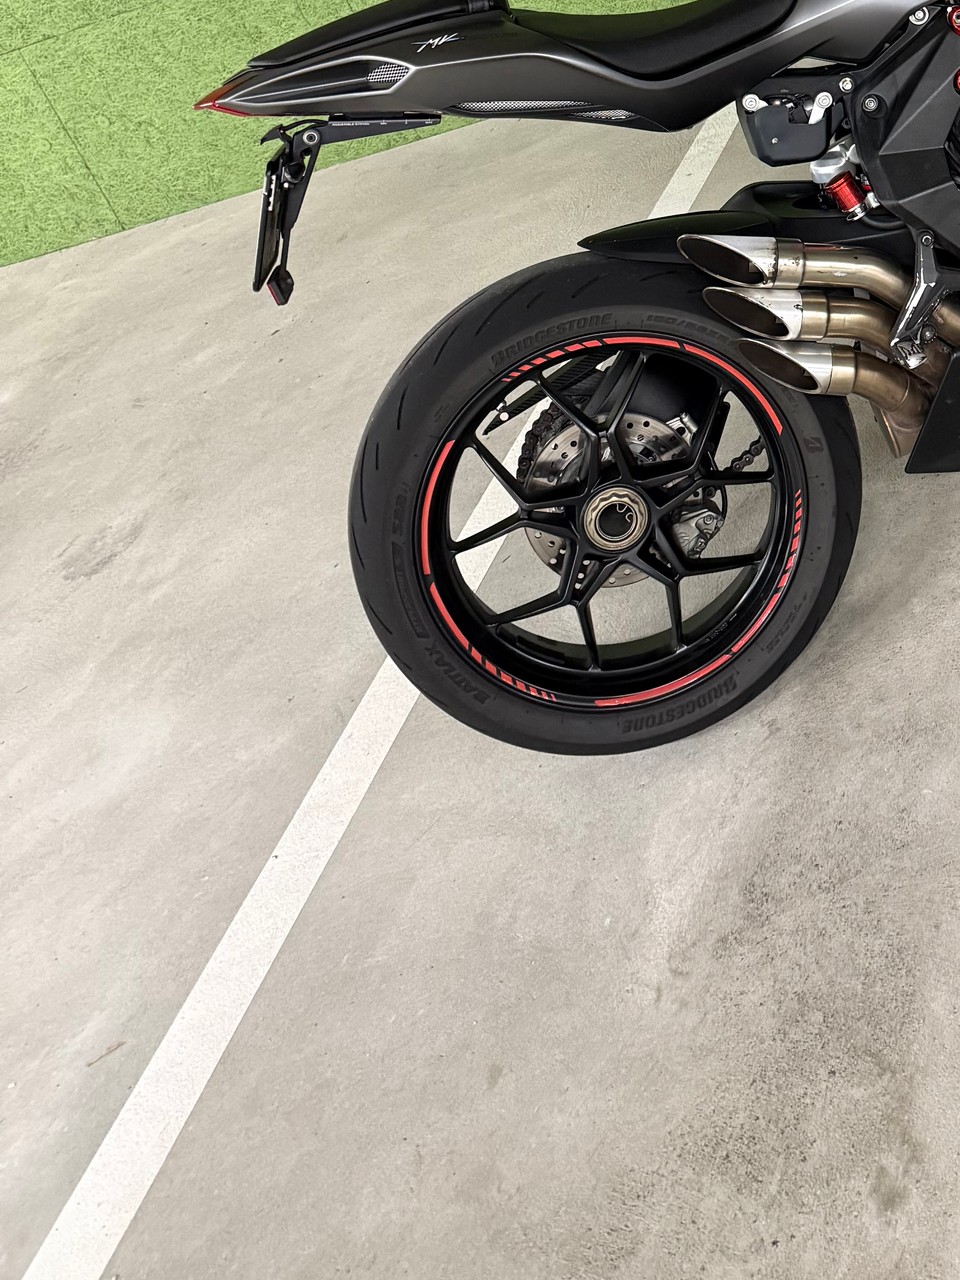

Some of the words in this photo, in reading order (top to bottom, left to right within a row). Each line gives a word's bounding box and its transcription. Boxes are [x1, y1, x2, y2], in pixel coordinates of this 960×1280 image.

[412, 32, 463, 53] MV
[490, 313, 614, 370] BRIDGESTONE
[425, 640, 491, 704] BATTLAX
[621, 673, 738, 734] BRIDGESTONE
